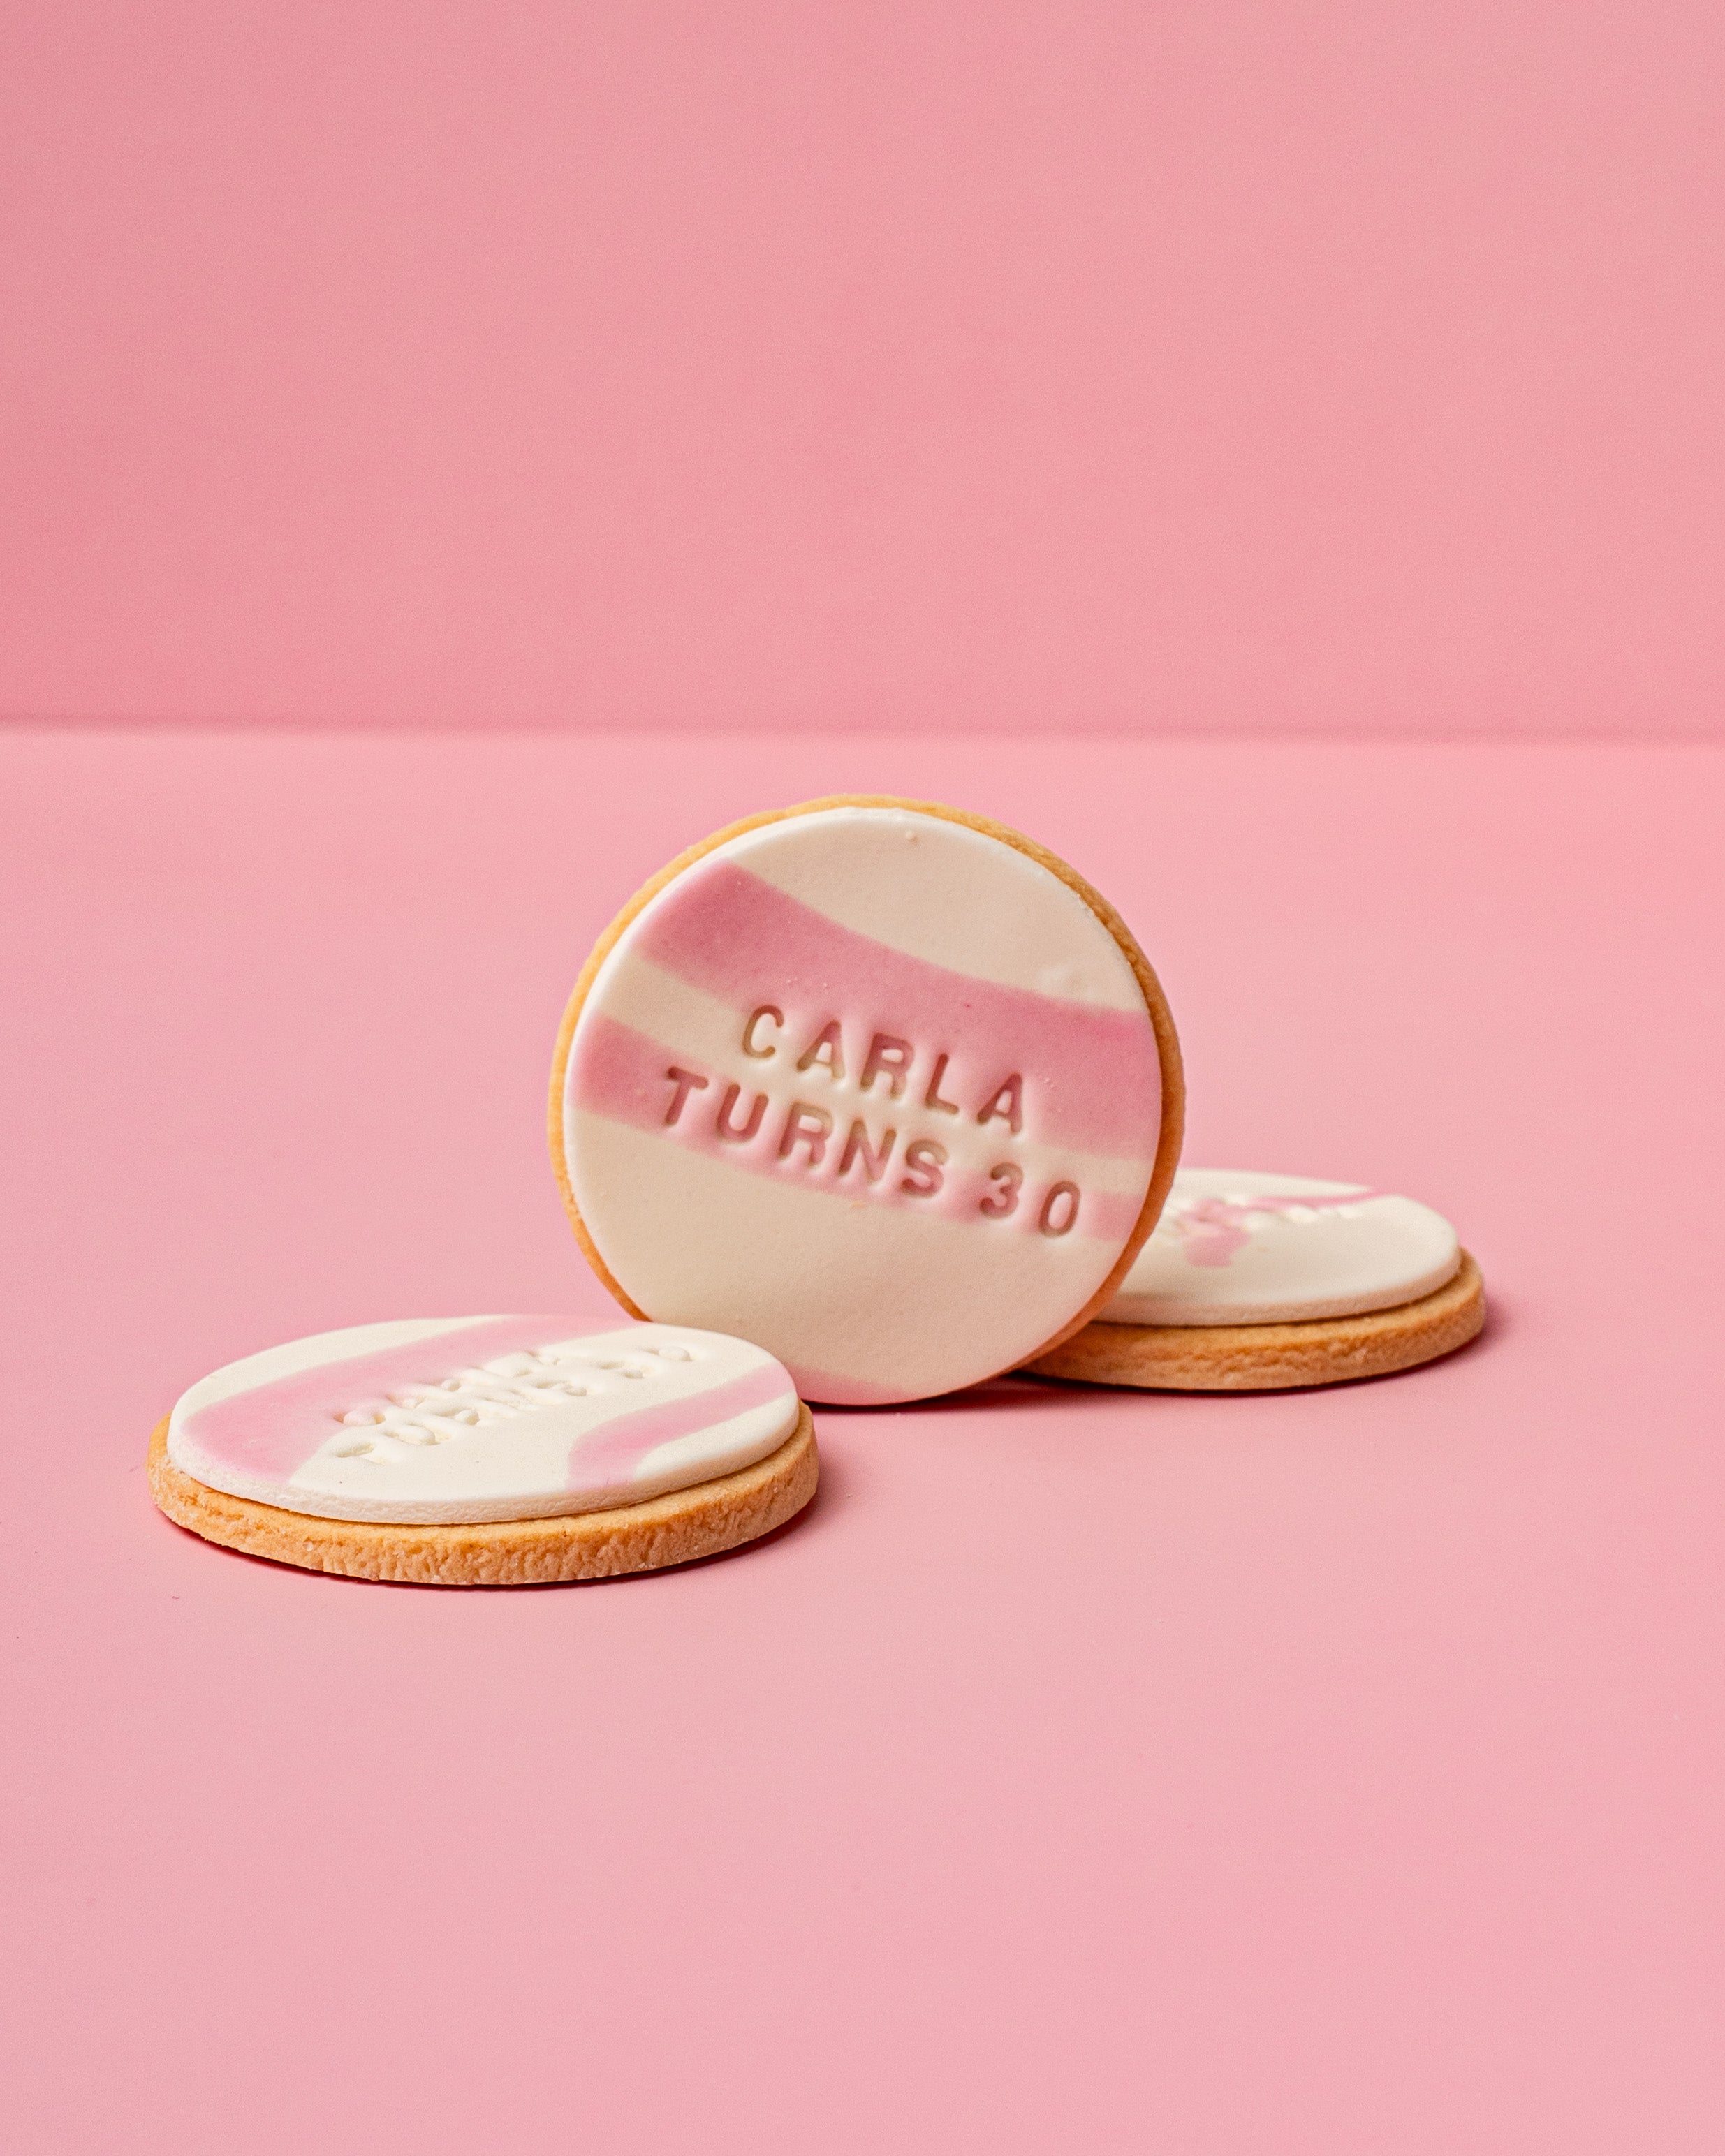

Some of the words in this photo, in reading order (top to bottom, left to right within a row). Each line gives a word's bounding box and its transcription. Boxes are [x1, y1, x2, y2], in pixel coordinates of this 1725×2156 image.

[742, 1005, 1023, 1134] CARLA
[663, 1066, 948, 1199] TURNS
[979, 1162, 1080, 1238] 30
